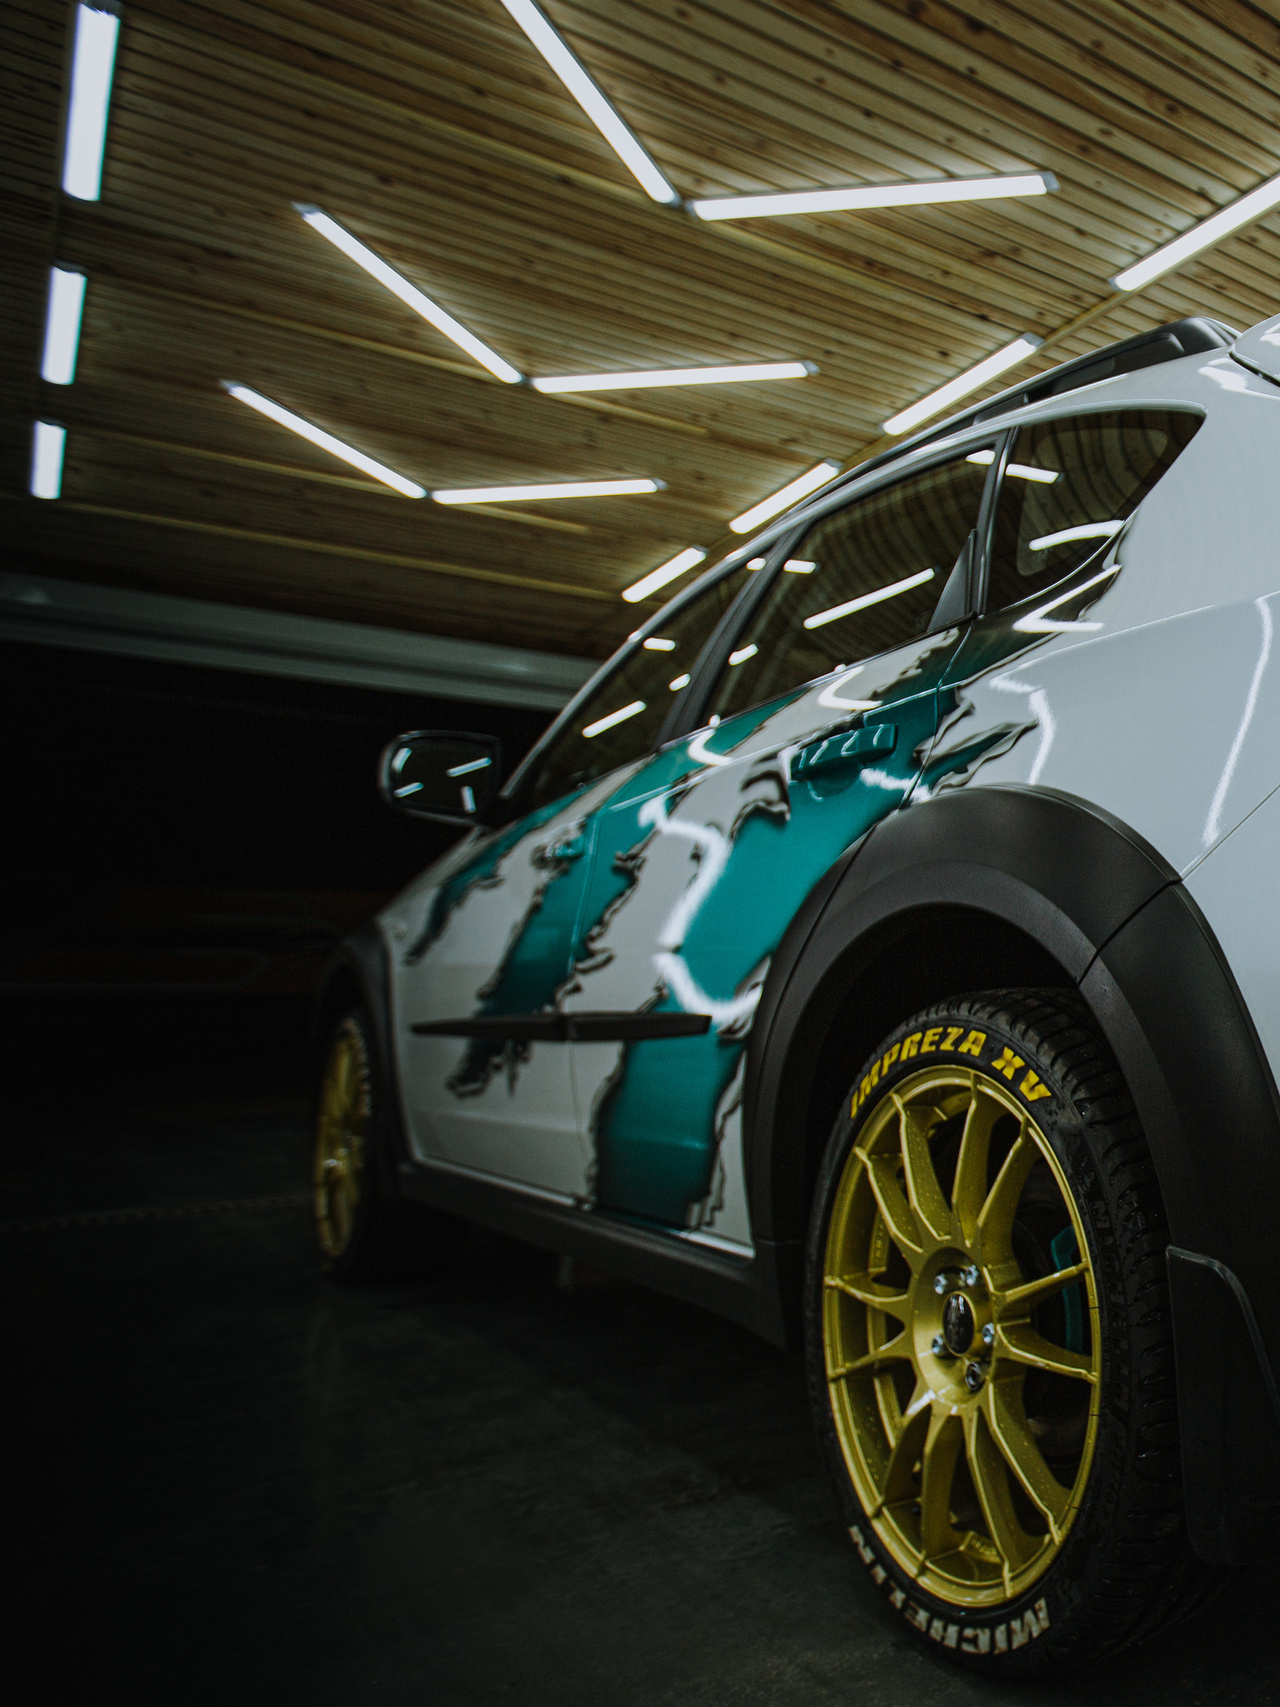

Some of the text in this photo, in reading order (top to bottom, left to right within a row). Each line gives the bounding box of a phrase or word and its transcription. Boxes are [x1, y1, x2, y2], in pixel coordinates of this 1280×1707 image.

[850, 1026, 1052, 1120] IMPREZA XV
[848, 1524, 1051, 1656] MICHELIN
